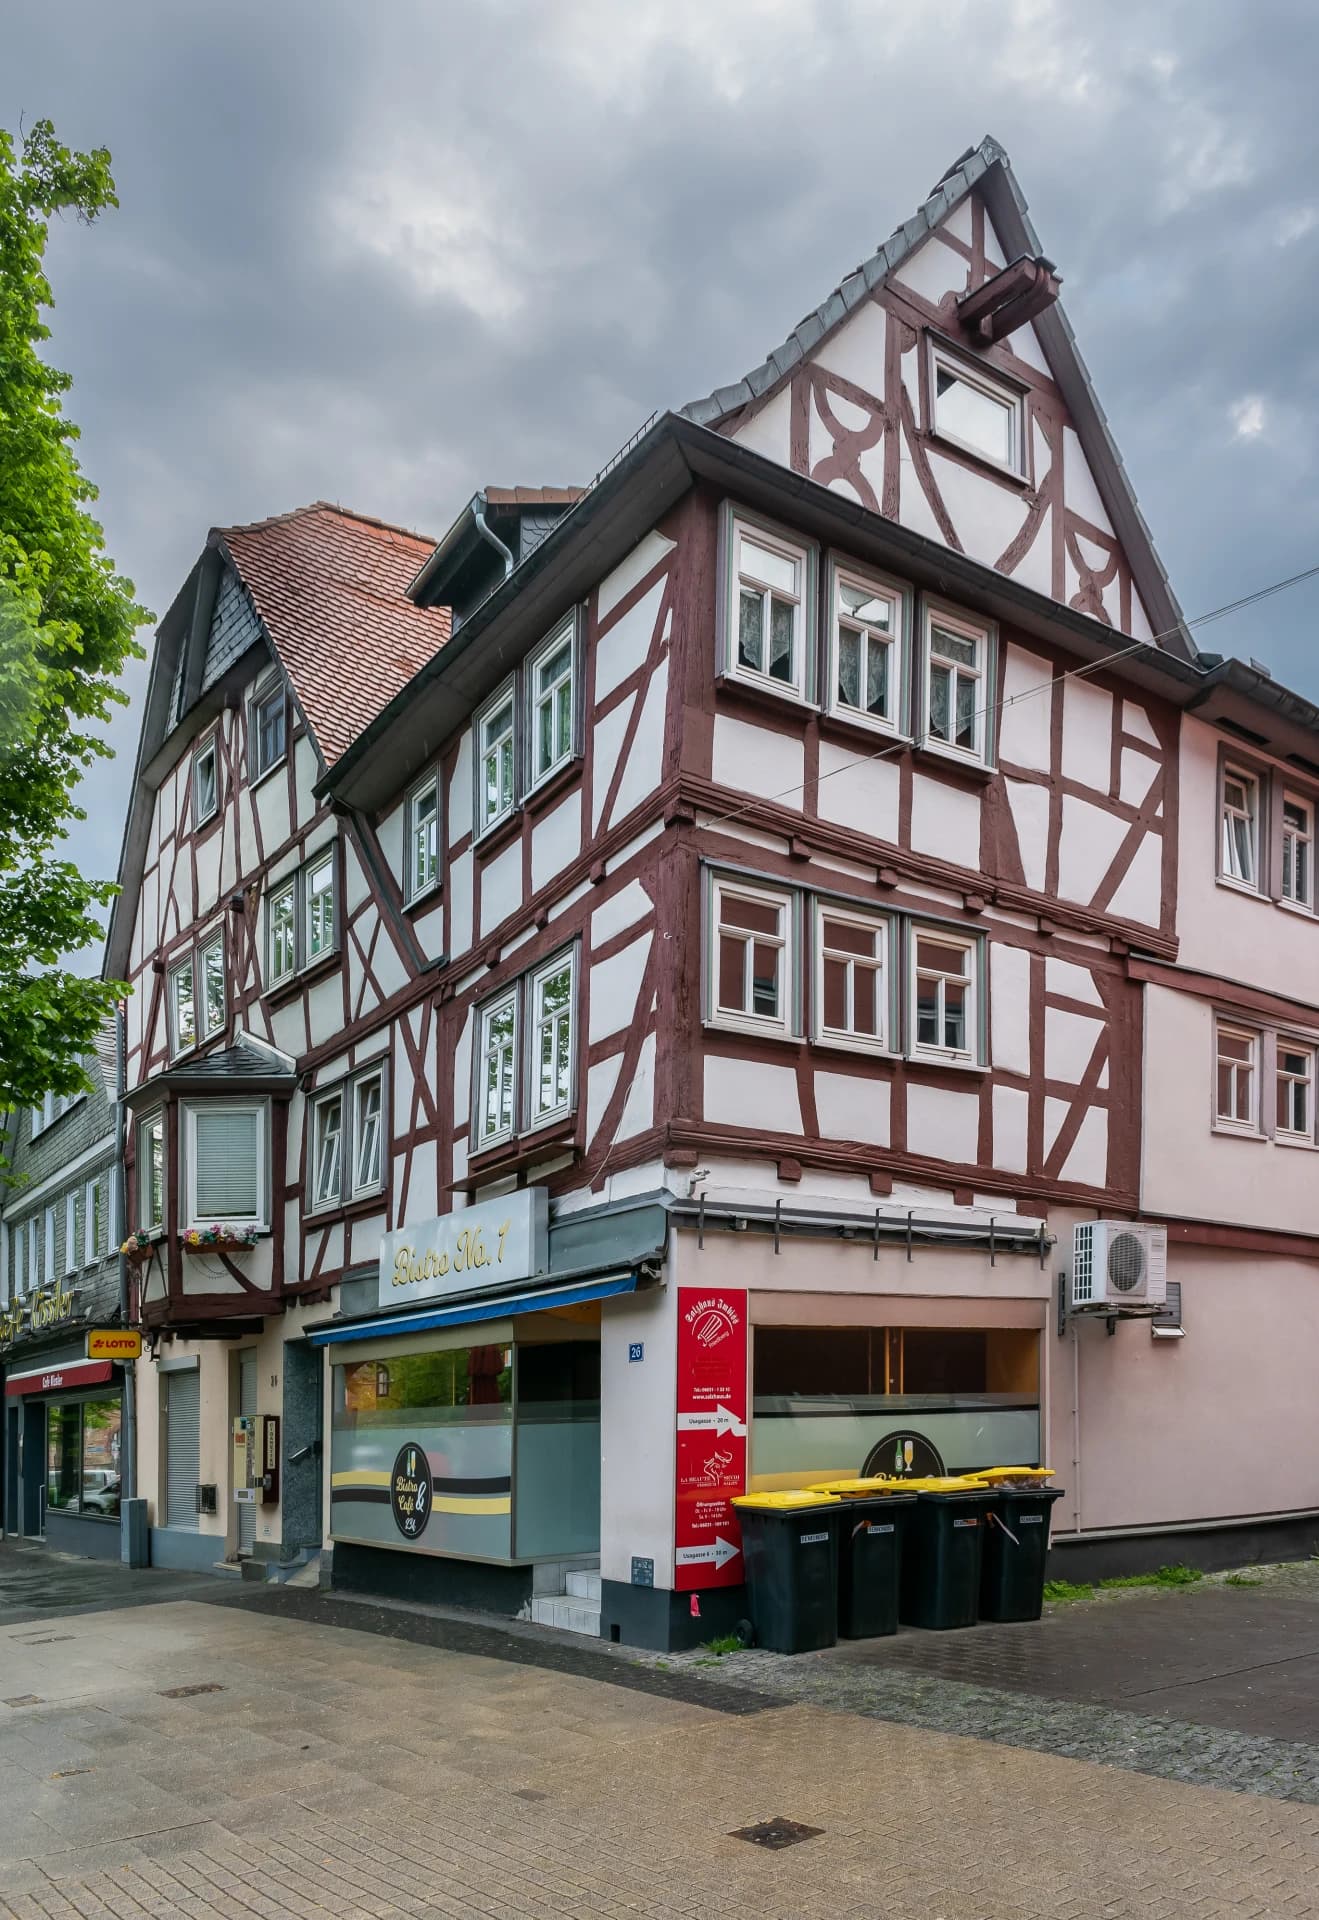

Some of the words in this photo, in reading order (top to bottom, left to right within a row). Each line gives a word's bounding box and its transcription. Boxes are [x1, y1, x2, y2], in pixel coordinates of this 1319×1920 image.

[392, 1246, 450, 1287] Bistro
[497, 1218, 511, 1264] 1
[105, 1340, 136, 1348] LOTTO
[631, 1346, 641, 1358] 26
[395, 1476, 417, 1491] Bistro
[399, 1495, 414, 1515] Café
[416, 1481, 427, 1512] &
